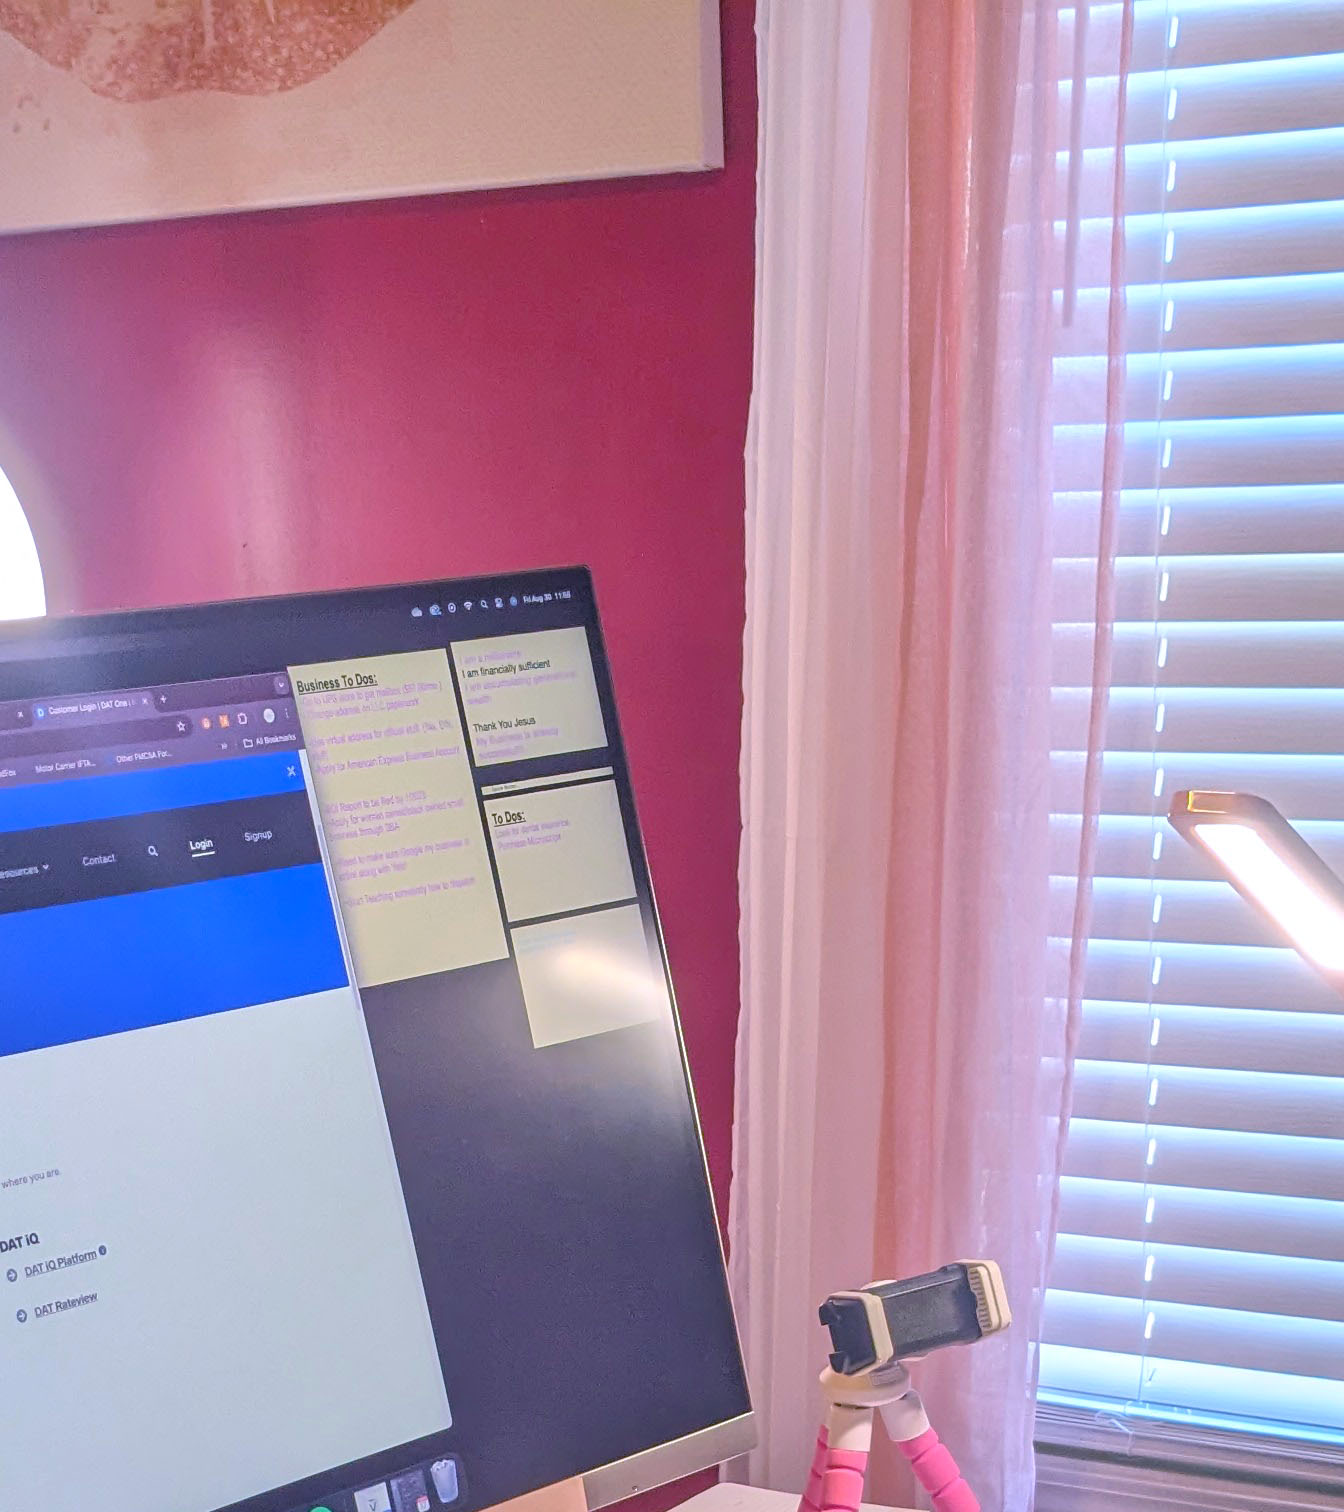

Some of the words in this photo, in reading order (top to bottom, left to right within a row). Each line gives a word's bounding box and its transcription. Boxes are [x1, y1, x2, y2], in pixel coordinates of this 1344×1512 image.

[467, 668, 479, 679] am
[480, 661, 517, 679] financially
[518, 658, 551, 672] sufficient
[296, 676, 341, 695] Business
[341, 675, 356, 688] To
[355, 673, 378, 687] Dos:
[473, 721, 498, 734] Thank
[498, 718, 513, 731] You
[514, 716, 536, 729] Jesus
[491, 811, 504, 826] To
[505, 808, 526, 824] Dos:
[190, 838, 213, 852] Login
[244, 829, 273, 845] Signup
[83, 853, 117, 868] Contact
[1, 1176, 28, 1190] where
[28, 1172, 45, 1185] you
[25, 1232, 42, 1248] iQ
[24, 1262, 44, 1278] DAT
[57, 1250, 97, 1270] Platform
[34, 1303, 54, 1319] DAT
[55, 1292, 98, 1313] Rateview
